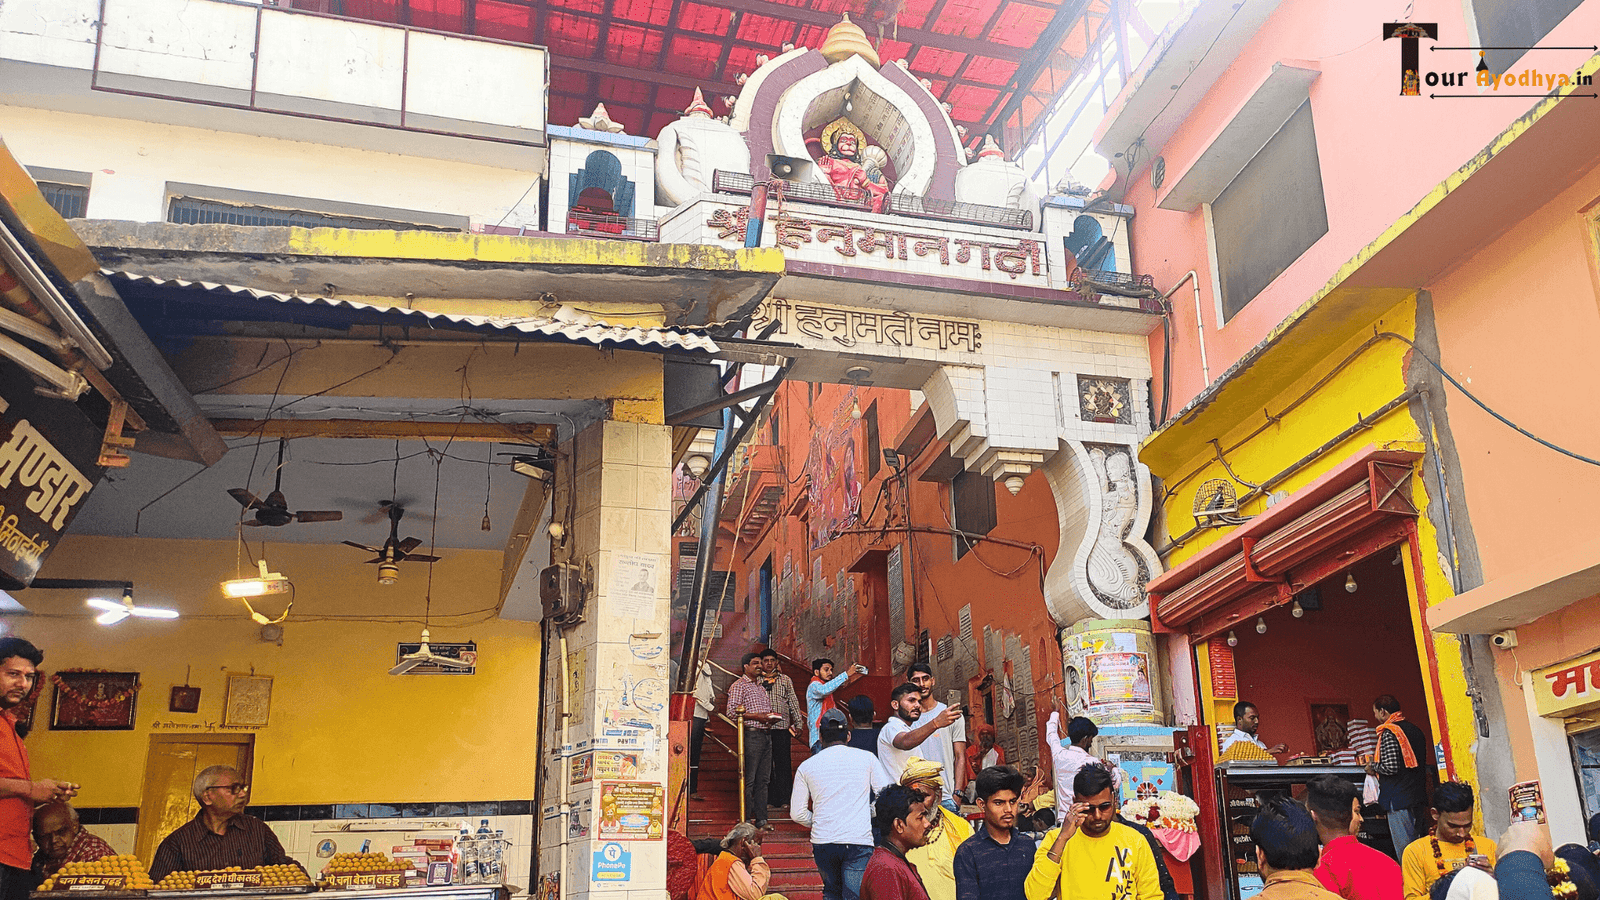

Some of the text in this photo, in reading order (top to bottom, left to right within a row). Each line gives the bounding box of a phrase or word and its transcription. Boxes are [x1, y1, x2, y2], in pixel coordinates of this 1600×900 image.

[751, 297, 982, 352] श्री हनुमते नमः
[353, 873, 376, 885] बेसन
